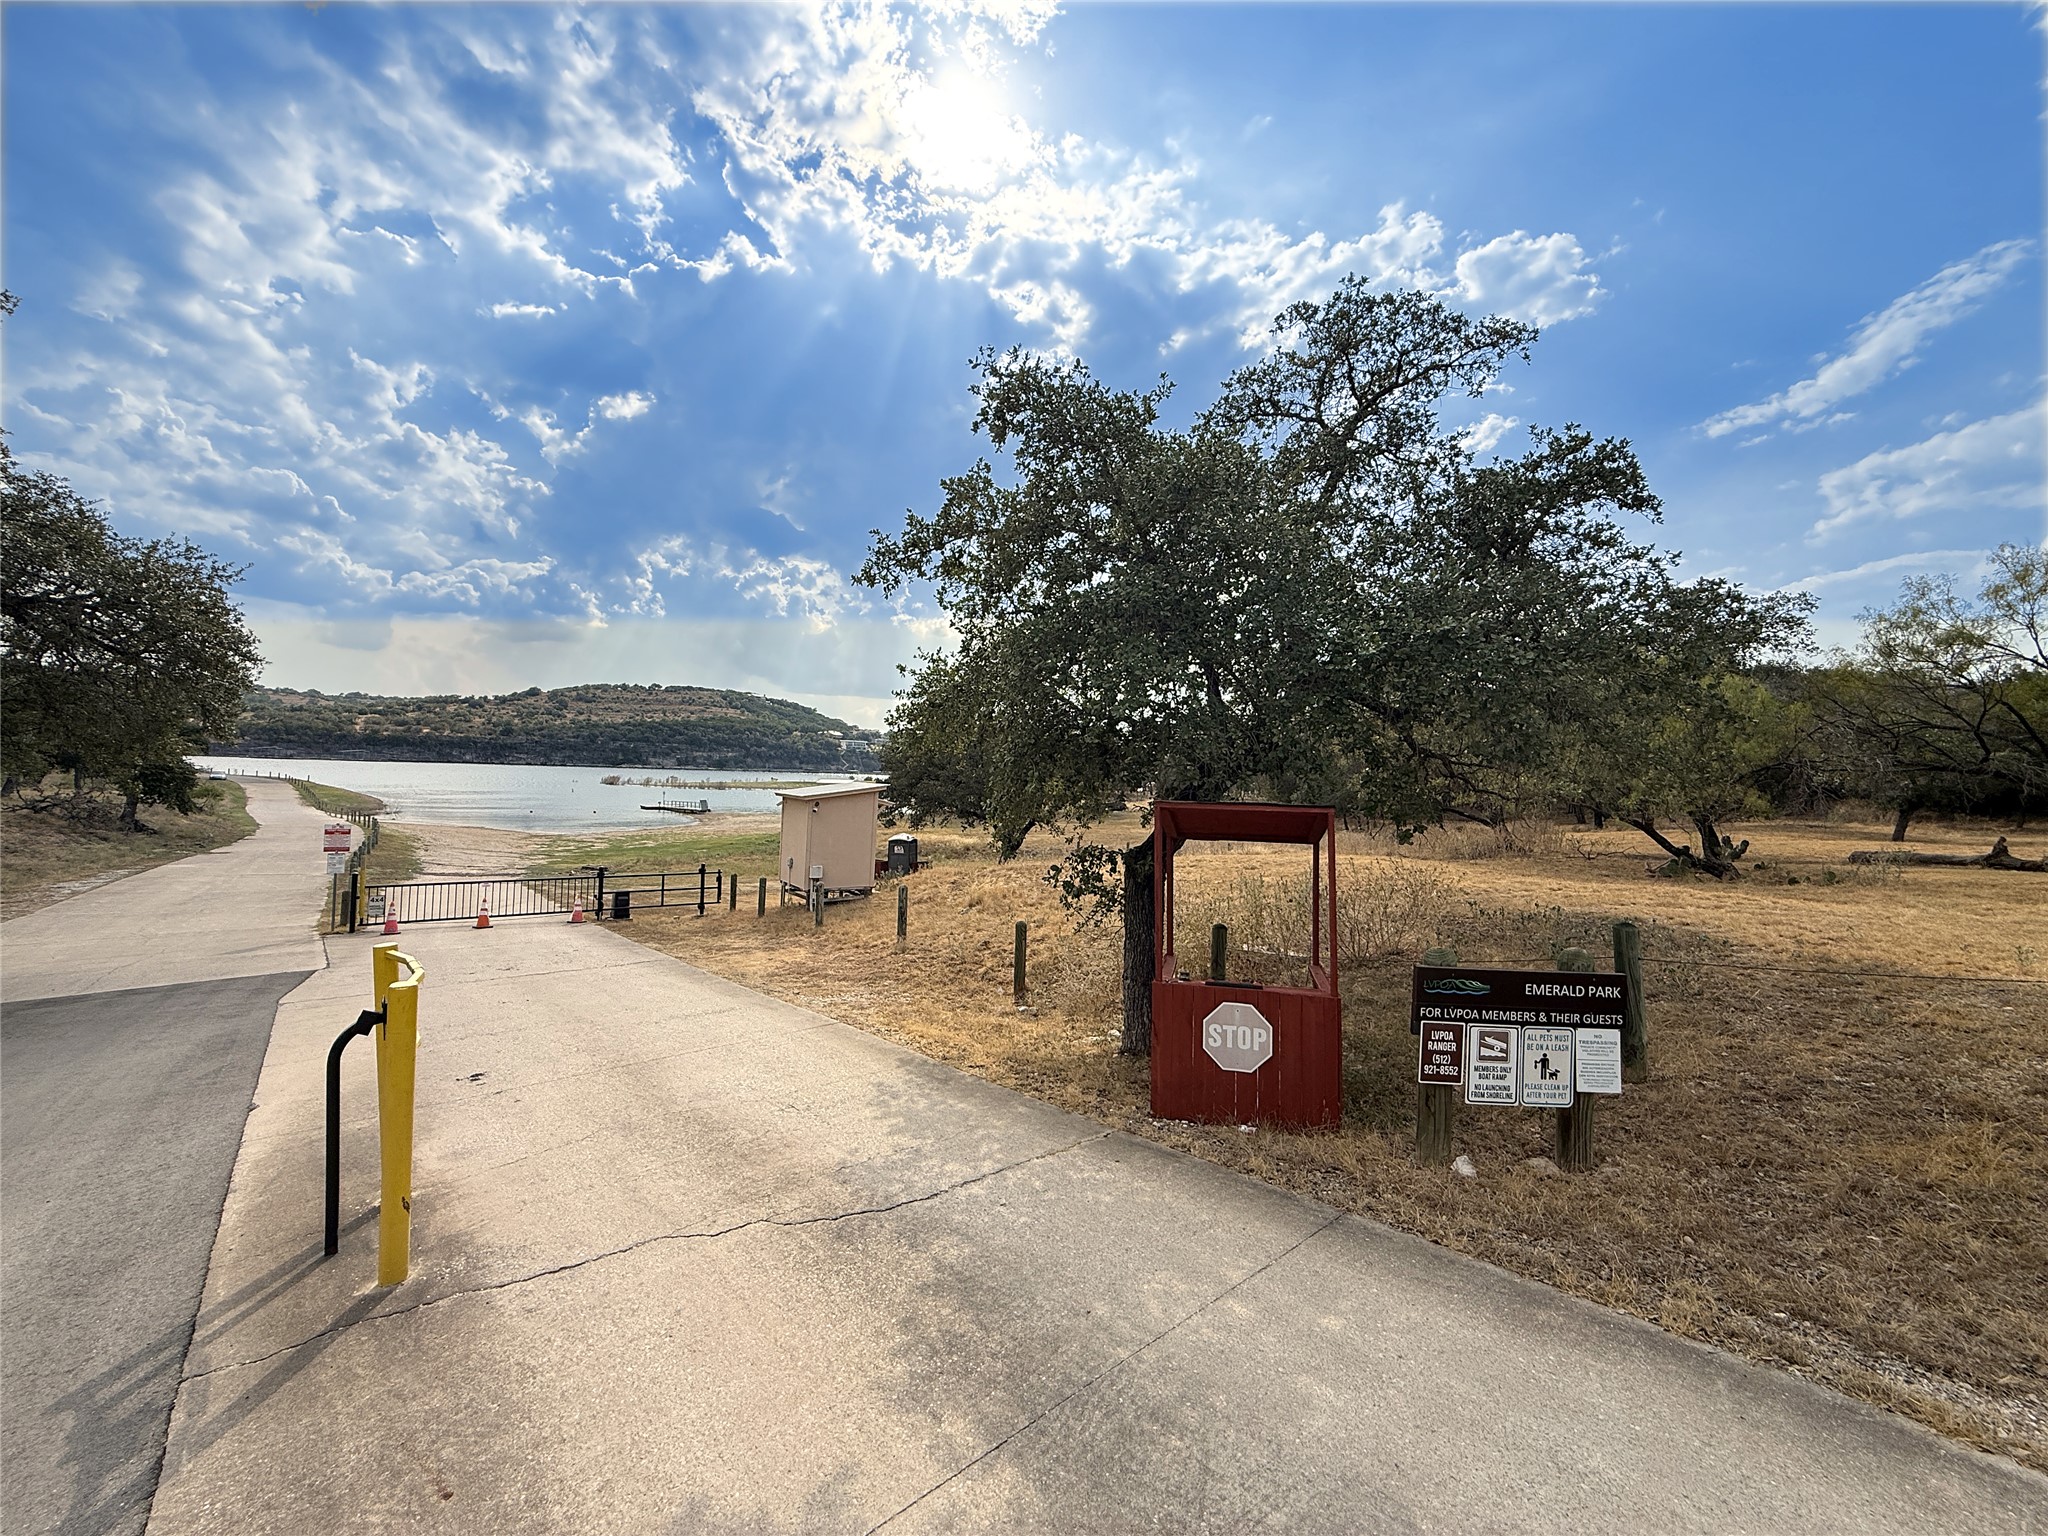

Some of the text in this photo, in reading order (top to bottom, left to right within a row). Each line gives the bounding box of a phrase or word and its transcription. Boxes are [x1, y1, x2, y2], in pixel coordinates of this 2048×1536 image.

[1525, 984, 1621, 998] EMERALD PARK
[1421, 1007, 1623, 1025] FOR LVPOA MEMBERS & THEIR GUESTS
[1208, 1023, 1266, 1050] STOP
[1432, 1030, 1453, 1041] LVPOA
[1555, 1034, 1569, 1042] MUST
[1428, 1042, 1456, 1052] RANGER
[1432, 1054, 1451, 1064] (512)
[1424, 1064, 1458, 1075] 921-8552
[1474, 1065, 1498, 1073] MEMBERS
[1492, 1073, 1507, 1081] RAMP
[1482, 1084, 1511, 1092] LAUNCHING
[1486, 1091, 1513, 1100] SHORELINE
[1542, 1091, 1555, 1099] YOUR
